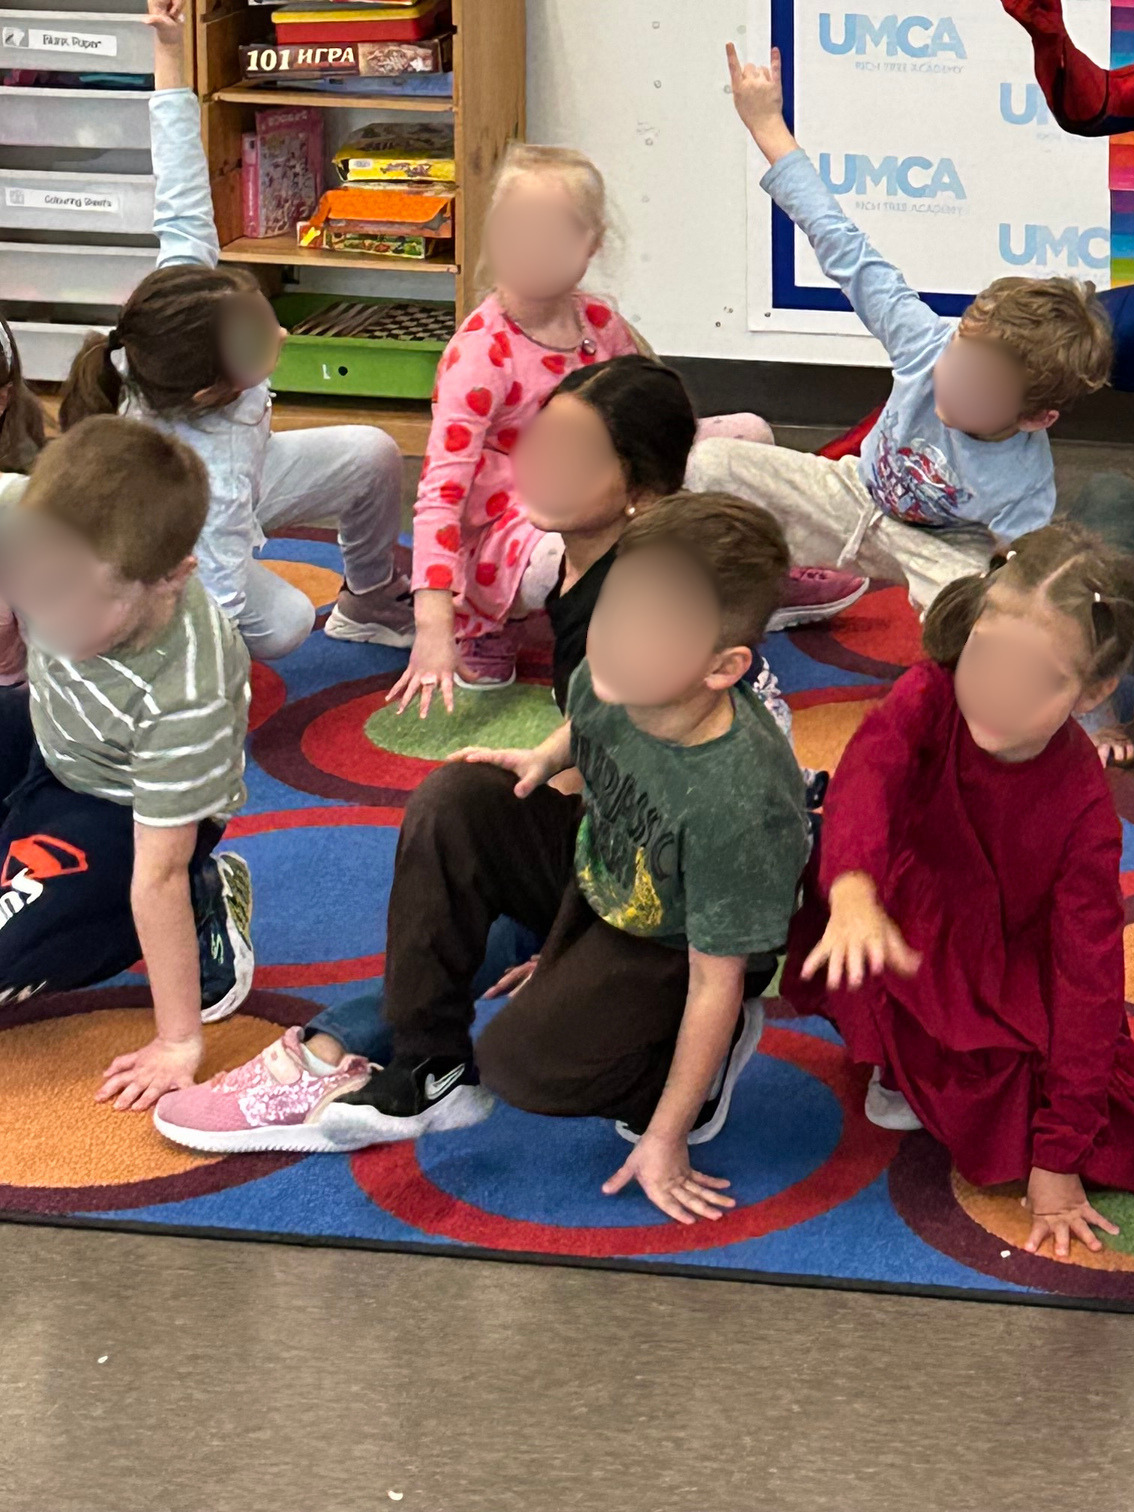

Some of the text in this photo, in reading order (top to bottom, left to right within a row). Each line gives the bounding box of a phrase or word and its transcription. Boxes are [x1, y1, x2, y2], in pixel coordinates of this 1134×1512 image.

[297, 47, 355, 64] ИГРА
[818, 12, 968, 59] UMCA
[246, 48, 291, 72] 101
[819, 152, 967, 200] UMCA
[999, 222, 1111, 271] UMC
